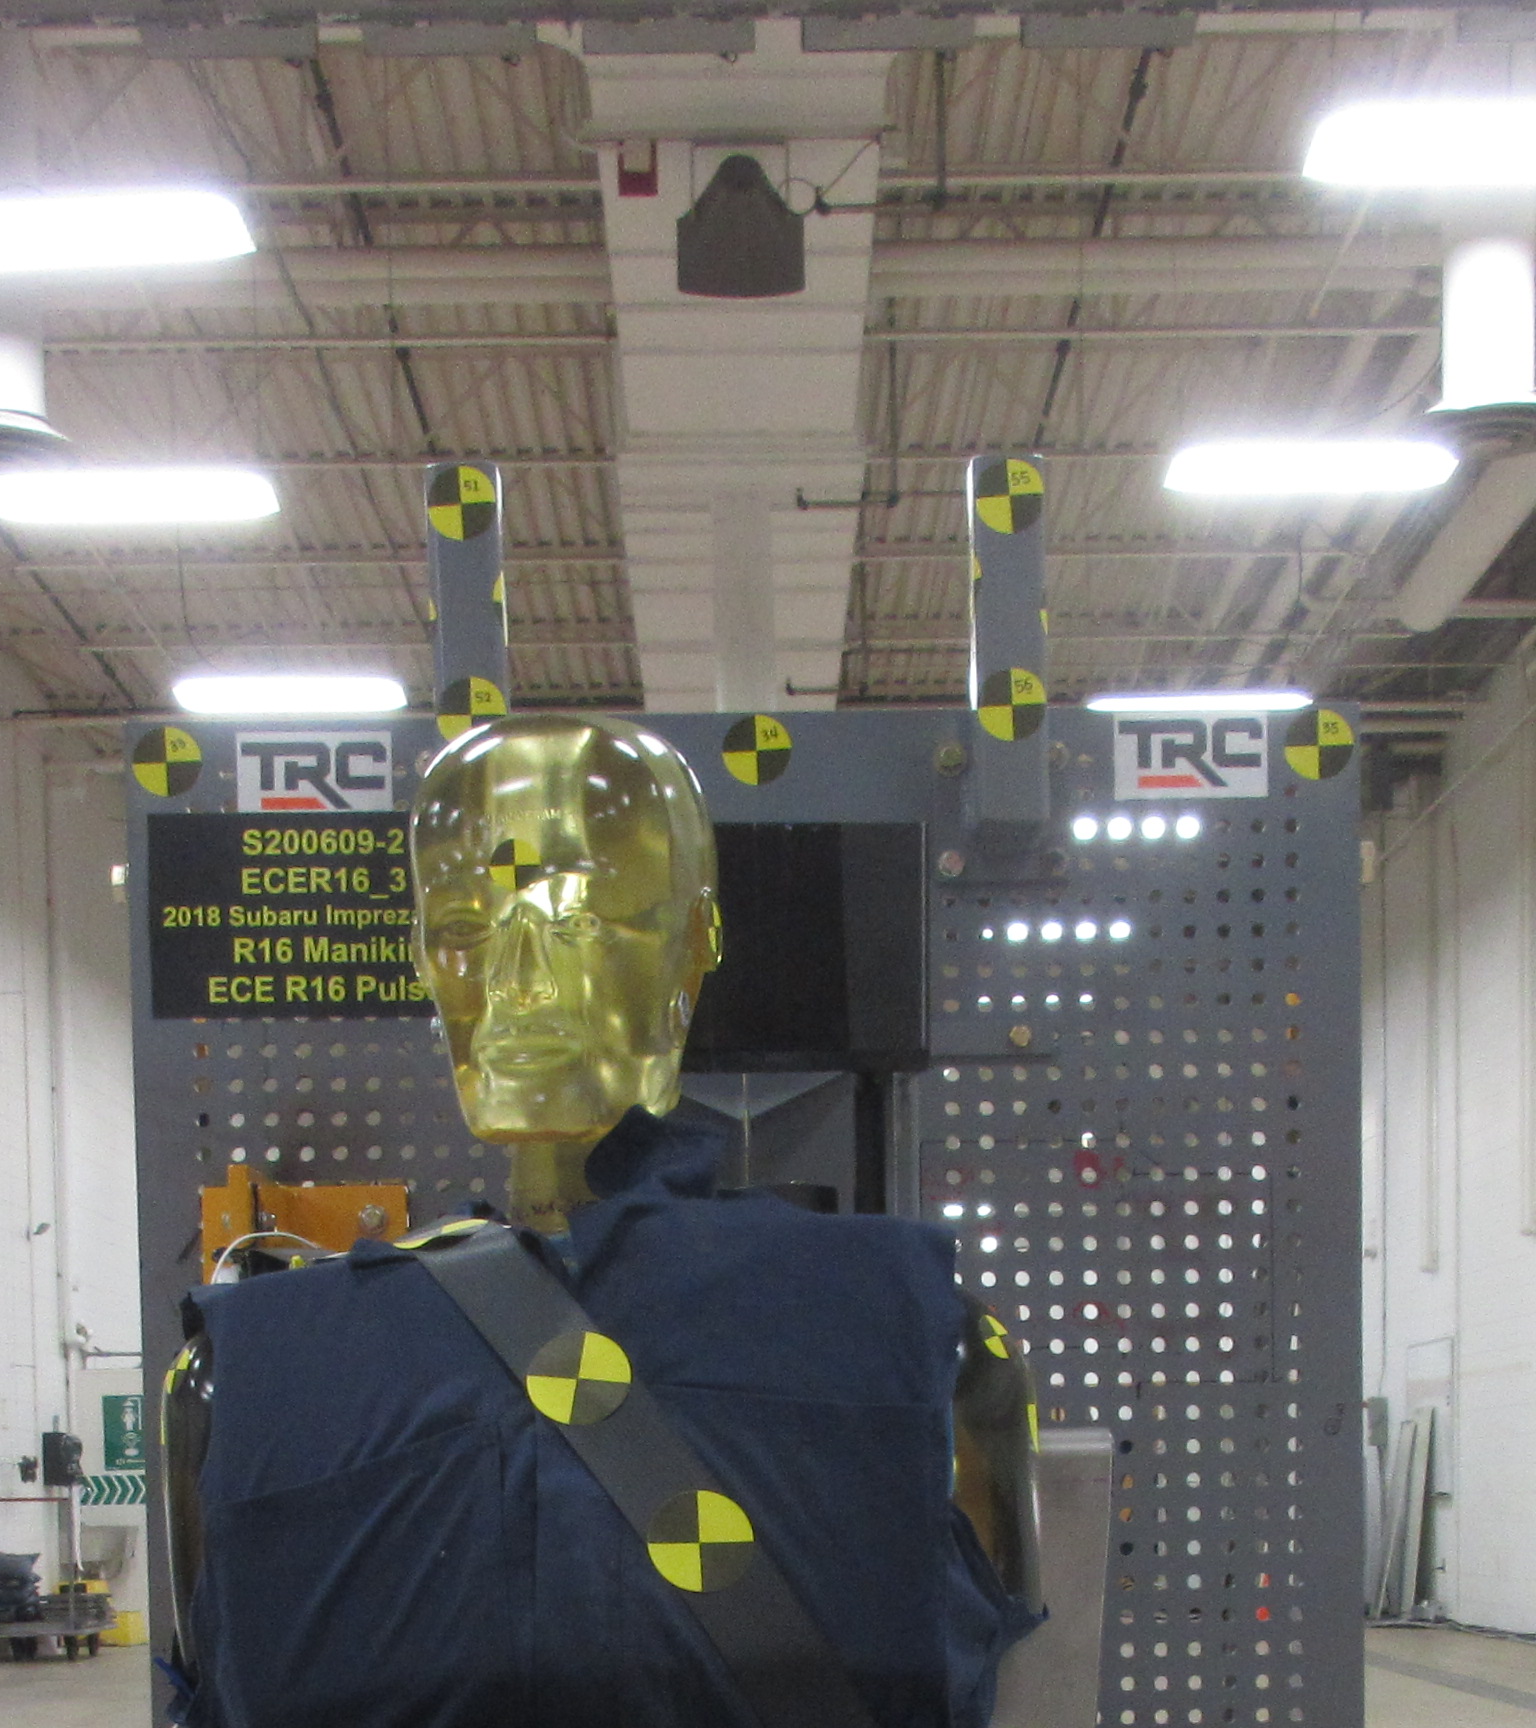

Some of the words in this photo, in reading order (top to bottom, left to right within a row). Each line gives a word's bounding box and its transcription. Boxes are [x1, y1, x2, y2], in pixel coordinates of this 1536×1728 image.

[464, 480, 480, 492] 51
[1011, 471, 1031, 486] 55
[1015, 680, 1033, 694] 56
[1118, 717, 1263, 788] TRC
[241, 741, 387, 810] TRC
[242, 828, 405, 856] S200609-2
[241, 867, 407, 900] ECER16_3
[163, 906, 222, 928] 2018
[228, 904, 318, 928] Subaru
[326, 903, 414, 930] Imprez
[233, 937, 293, 964] R16
[208, 976, 275, 1003] ECE
[285, 974, 346, 1002] R16
